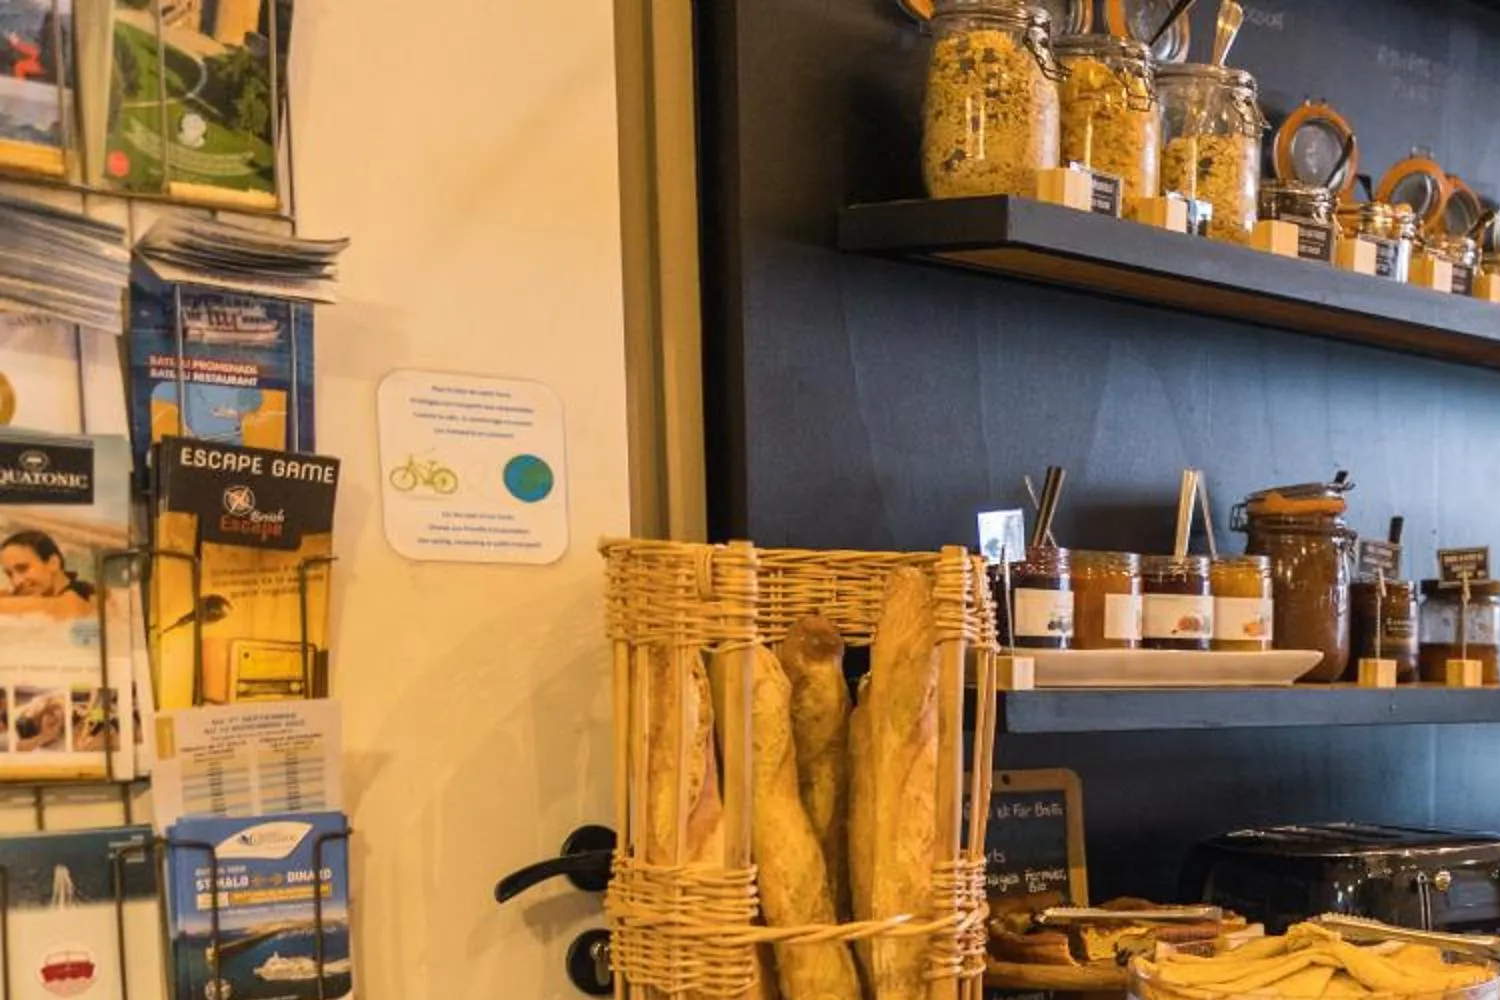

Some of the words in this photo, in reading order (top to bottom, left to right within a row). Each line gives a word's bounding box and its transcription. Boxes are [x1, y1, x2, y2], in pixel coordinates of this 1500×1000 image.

[180, 447, 264, 475] ESCAPE
[271, 459, 336, 484] GAME
[287, 867, 332, 883] DINAD
